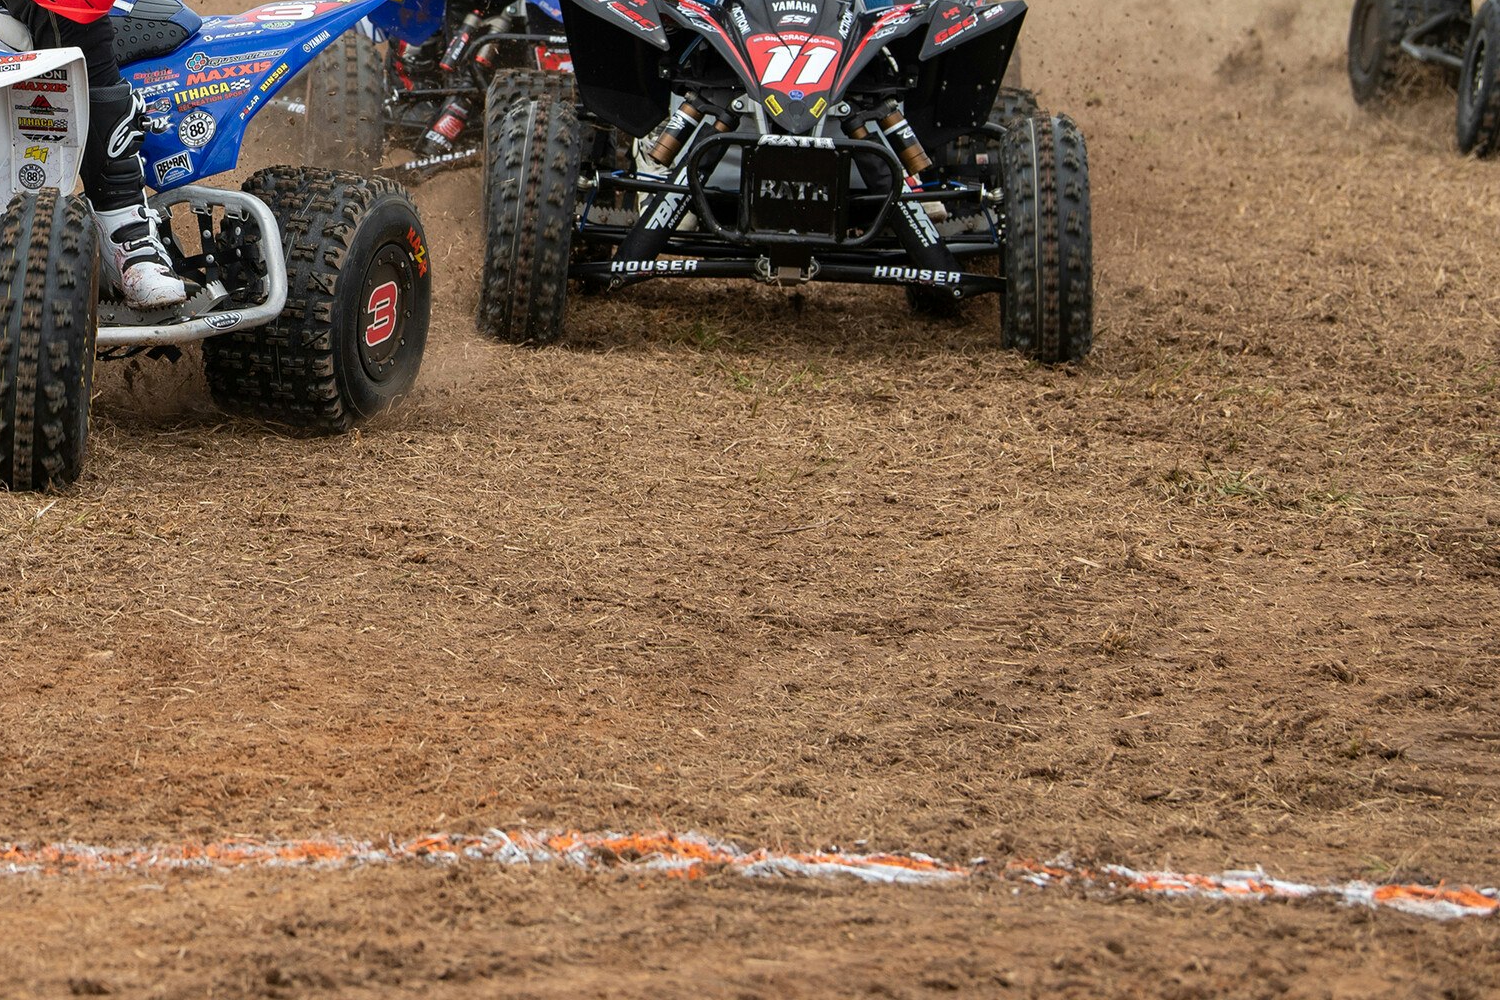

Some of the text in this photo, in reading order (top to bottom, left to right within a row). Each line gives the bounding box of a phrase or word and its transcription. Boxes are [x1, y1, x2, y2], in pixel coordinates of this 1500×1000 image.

[256, 3, 318, 21] 3
[771, 0, 818, 14] YAMAHA
[982, 4, 1004, 19] SSI
[779, 14, 813, 25] SSI
[214, 29, 265, 40] SCOTT
[308, 30, 332, 49] YAMAHA
[185, 61, 273, 86] MAXXIS
[760, 45, 838, 86] 11
[259, 62, 290, 93] HINSON
[12, 81, 69, 93] MAXXIS
[174, 82, 231, 105] ITHACA
[239, 95, 260, 120] POLAR
[17, 117, 54, 128] ITHACA
[189, 121, 206, 138] 88
[757, 134, 835, 149] RATH
[26, 171, 38, 182] 88
[759, 178, 829, 202] RATH
[897, 200, 930, 248] otorsports
[611, 259, 698, 273] HOUSER
[874, 264, 962, 284] HOUSER
[365, 280, 399, 348] 3
